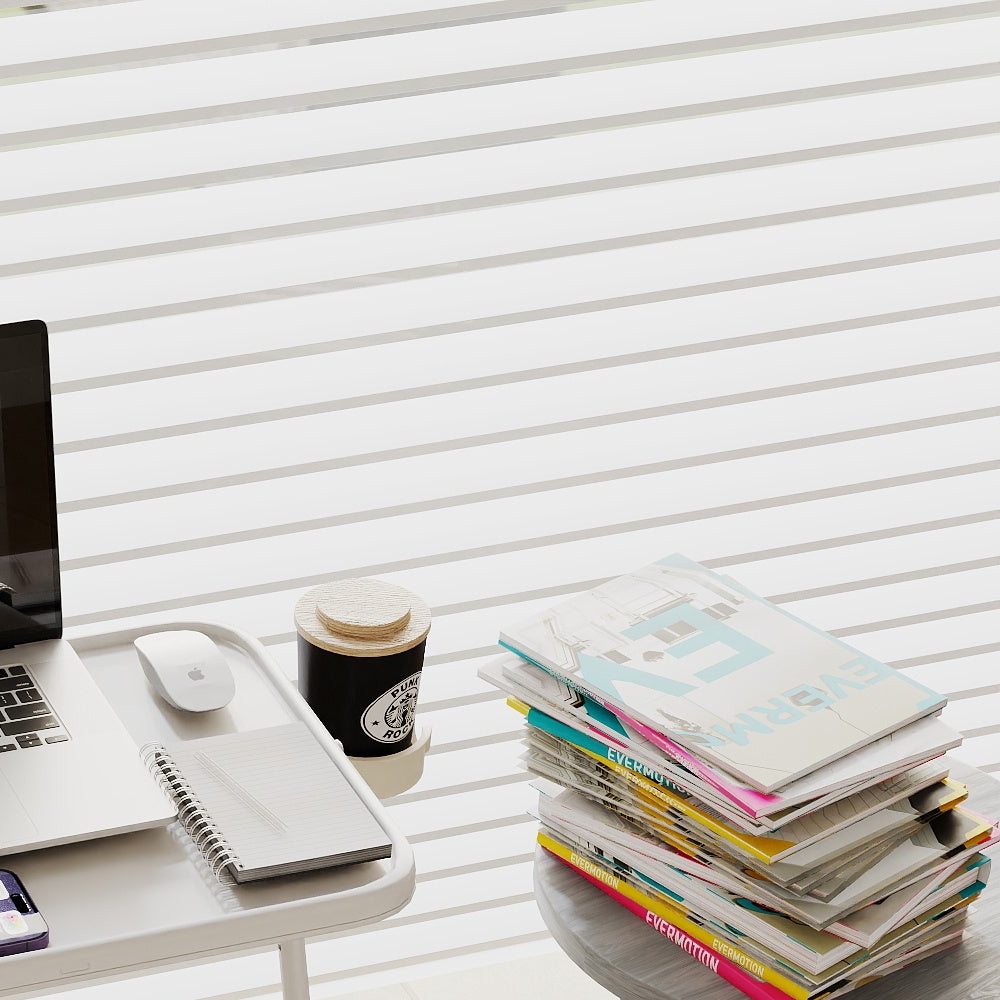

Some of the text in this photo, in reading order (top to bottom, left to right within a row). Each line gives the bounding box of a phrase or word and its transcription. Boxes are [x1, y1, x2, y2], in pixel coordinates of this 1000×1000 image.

[391, 676, 420, 698] PUNK
[570, 852, 620, 890] EVERMOTION
[645, 909, 720, 974] EVERMOTION
[712, 937, 765, 978] EVERMOTION
